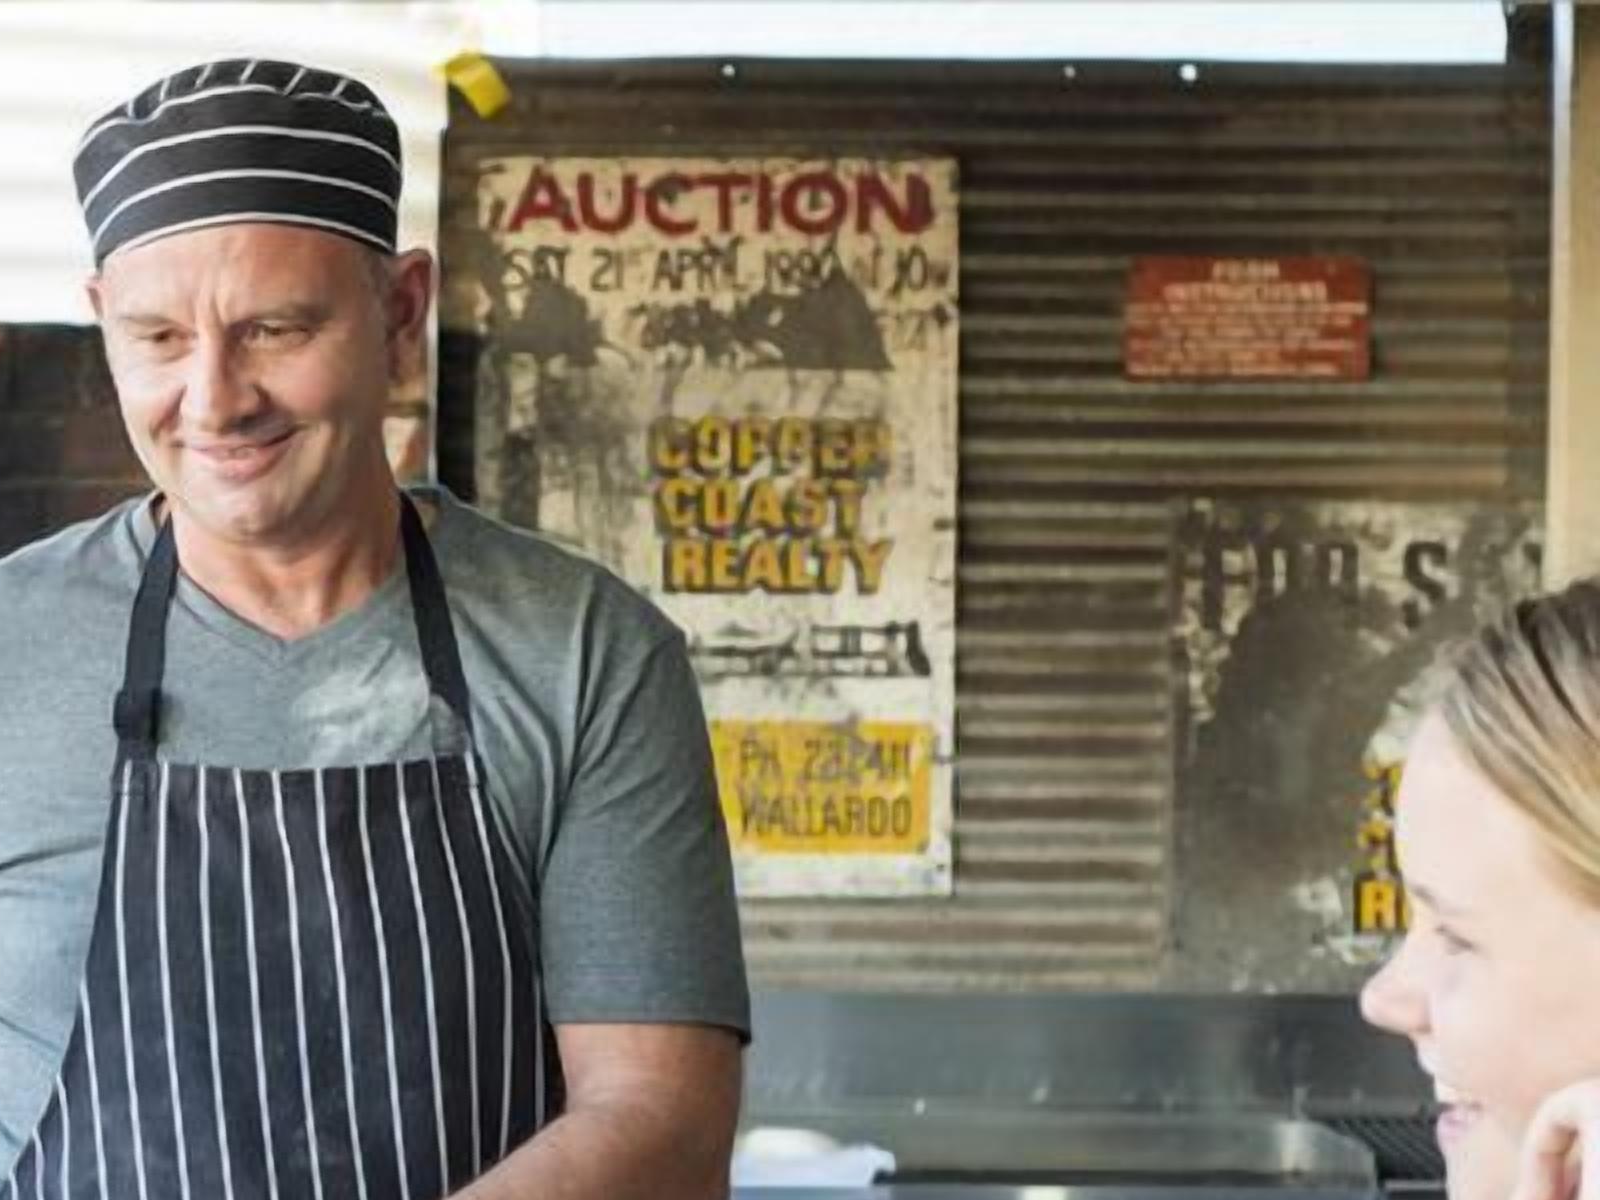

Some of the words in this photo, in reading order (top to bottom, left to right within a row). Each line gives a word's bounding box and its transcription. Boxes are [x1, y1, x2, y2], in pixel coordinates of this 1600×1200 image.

[509, 166, 936, 236] AUCTION
[655, 479, 866, 537] COAST
[662, 537, 894, 594] REALTY
